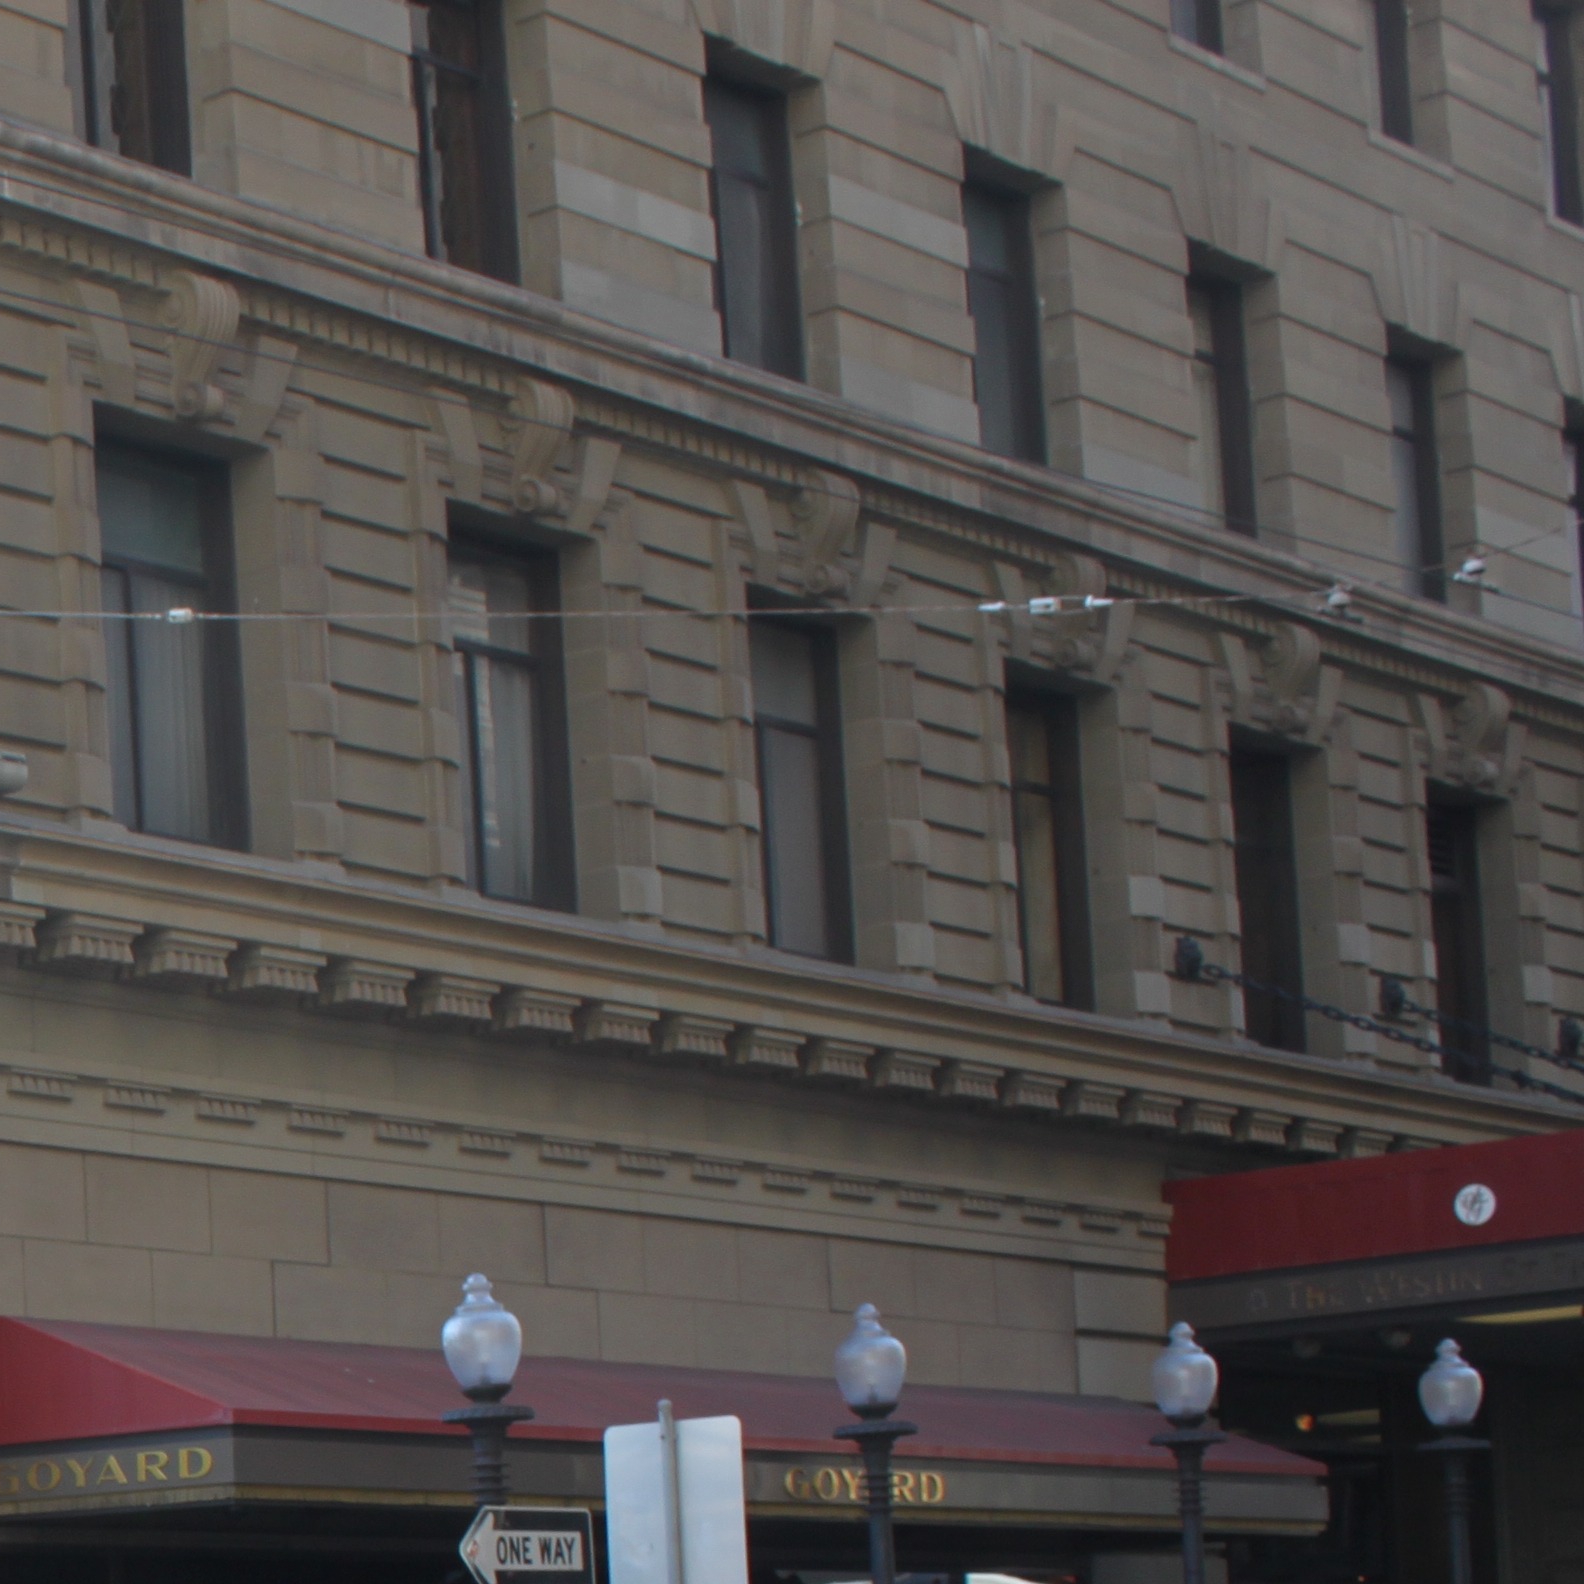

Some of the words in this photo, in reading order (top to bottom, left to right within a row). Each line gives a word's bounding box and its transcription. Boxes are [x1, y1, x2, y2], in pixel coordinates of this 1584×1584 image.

[784, 1466, 946, 1504] GOYRD
[496, 1535, 533, 1565] ONE
[538, 1536, 576, 1565] WAY
